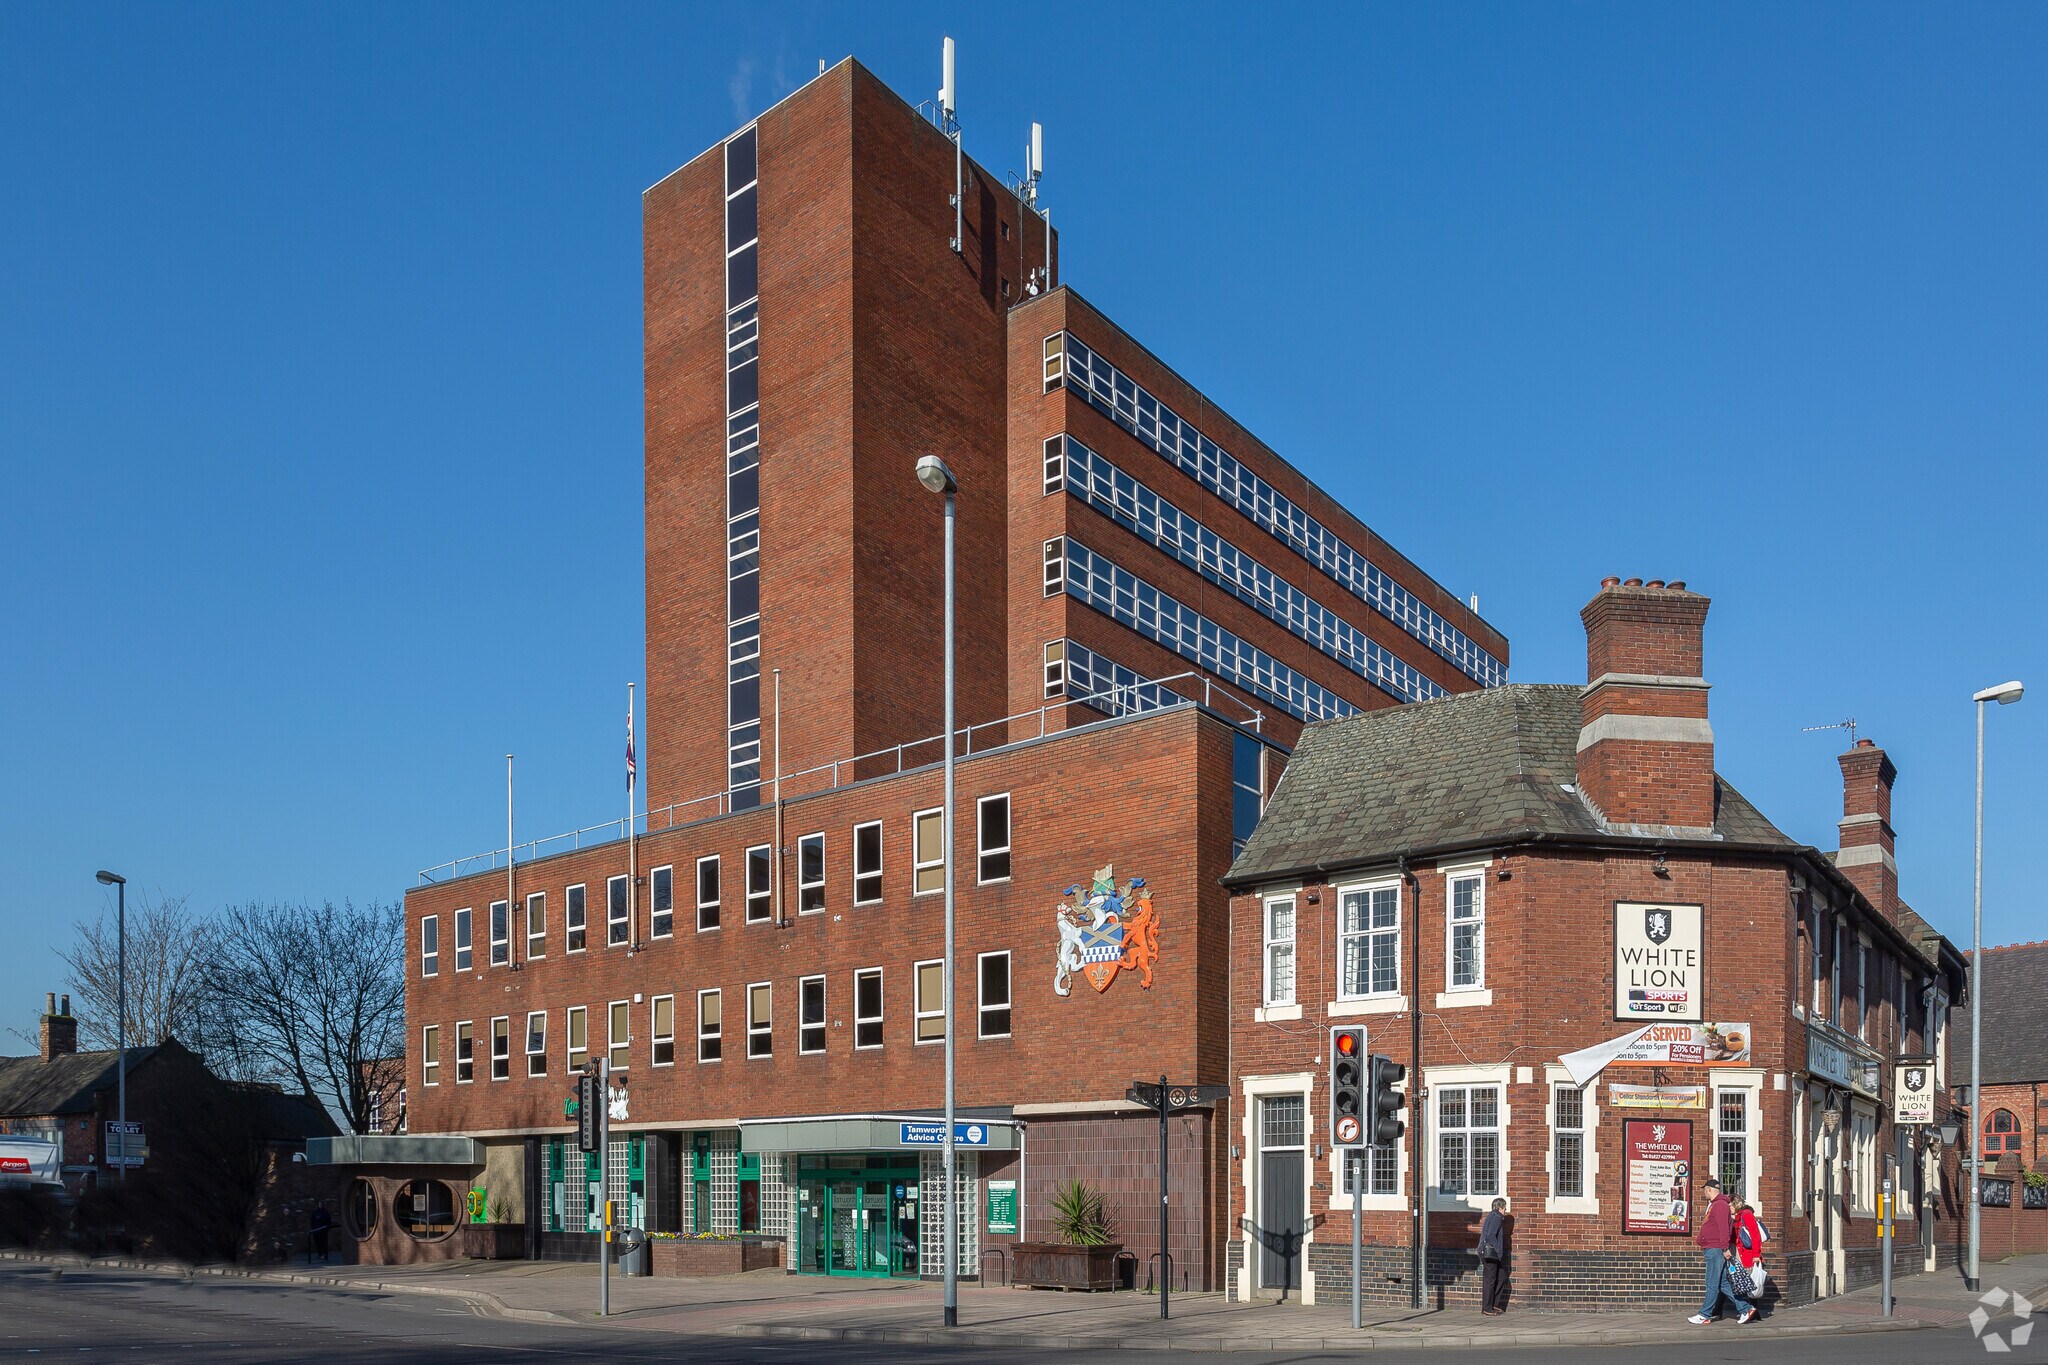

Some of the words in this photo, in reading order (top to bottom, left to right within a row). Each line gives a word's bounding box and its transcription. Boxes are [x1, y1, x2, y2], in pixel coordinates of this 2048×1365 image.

[1621, 947, 1696, 967] WHITE
[1631, 969, 1685, 987] LION
[1647, 991, 1686, 1001] SPORTS
[1652, 1027, 1692, 1042] SERVED
[1654, 1043, 1667, 1051] 5pm
[1672, 1045, 1688, 1053] 20%
[1689, 1046, 1702, 1054] Off
[1634, 1052, 1648, 1060] 5pm
[1898, 1094, 1931, 1102] WHITE
[1902, 1102, 1927, 1110] LION
[124, 1126, 140, 1134] LET
[906, 1125, 946, 1134] Tamworth
[906, 1133, 935, 1142] Advice
[1635, 1142, 1647, 1150] THE
[1647, 1143, 1667, 1151] WHITE
[1, 1161, 28, 1169] Argos
